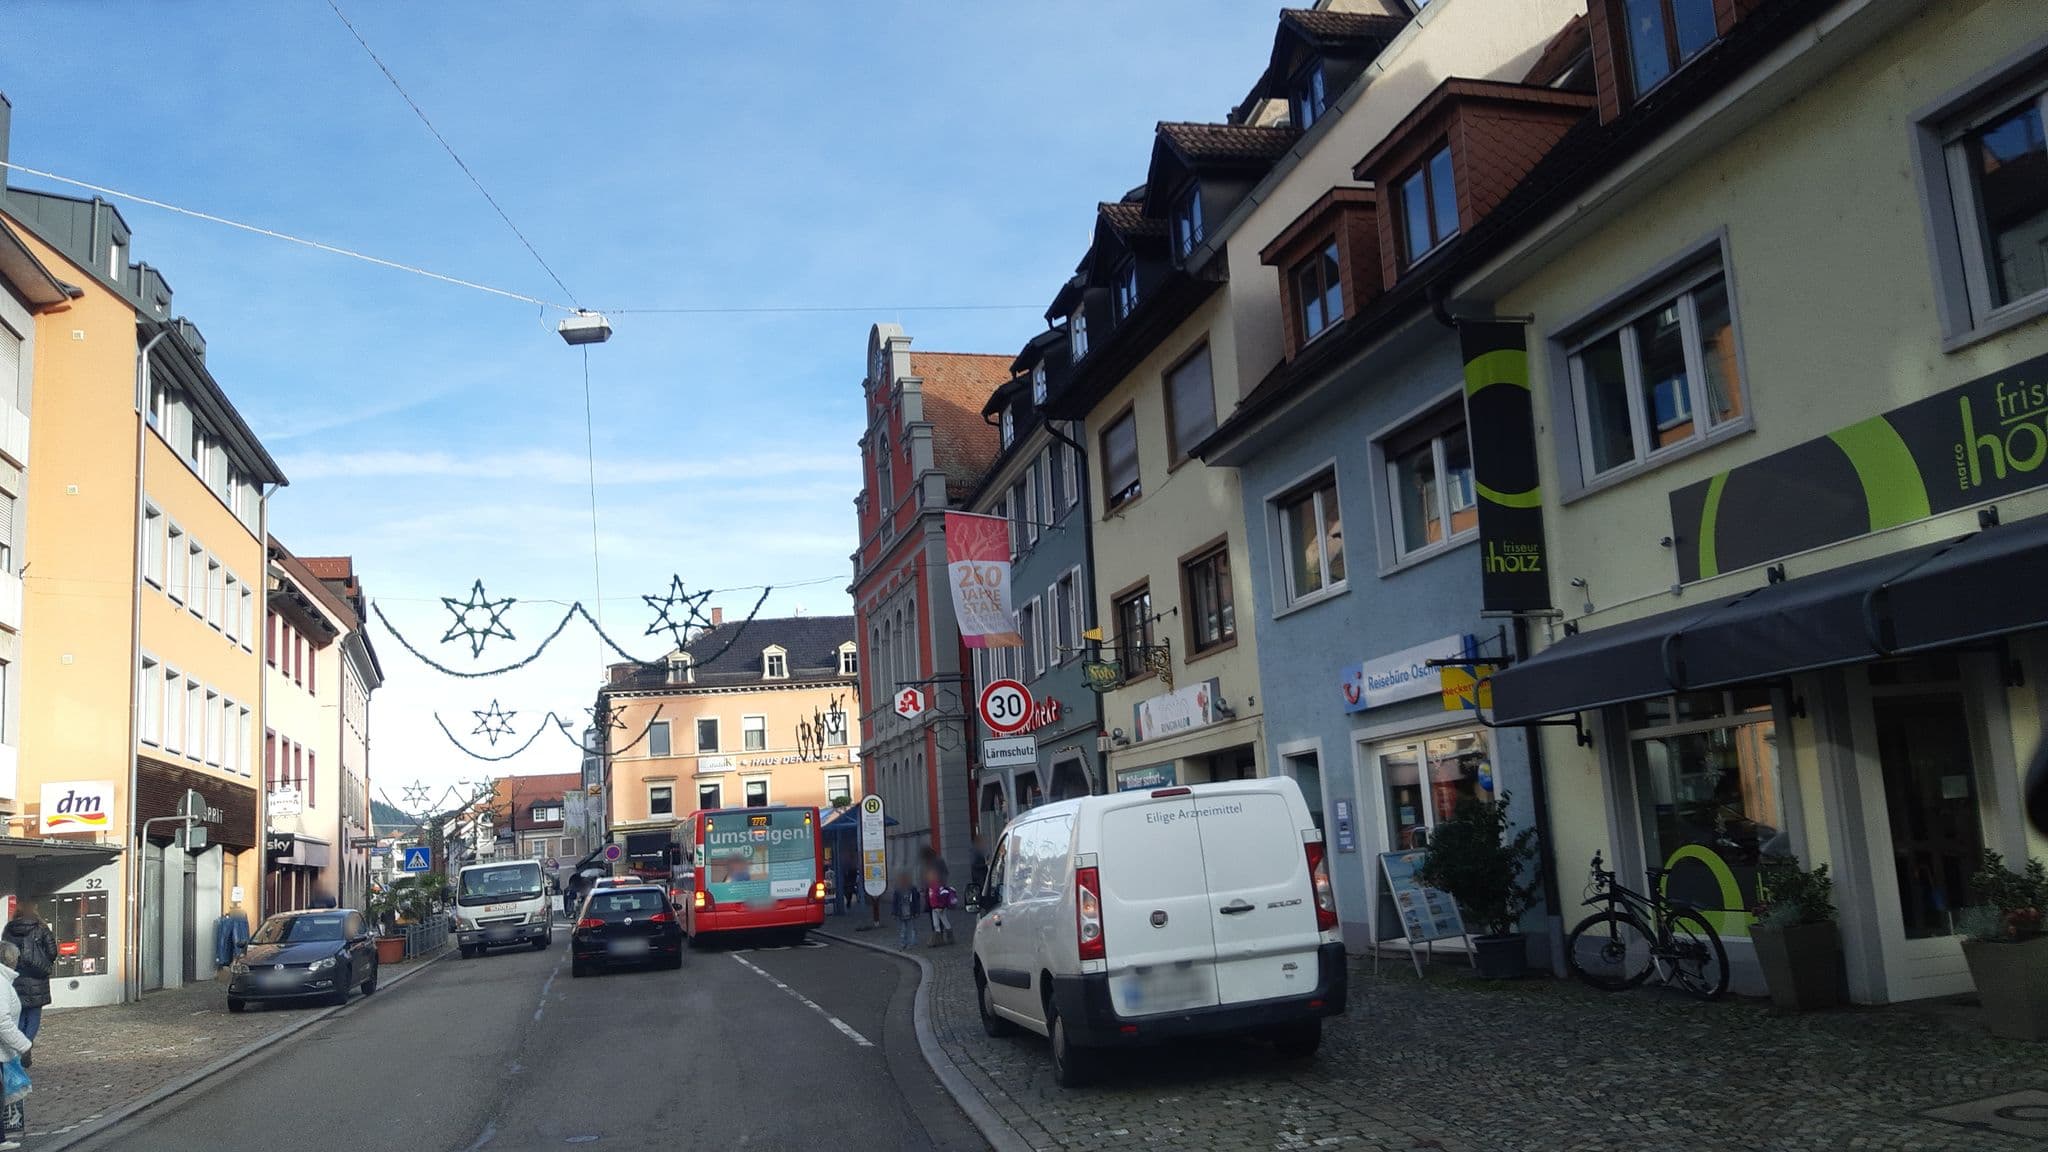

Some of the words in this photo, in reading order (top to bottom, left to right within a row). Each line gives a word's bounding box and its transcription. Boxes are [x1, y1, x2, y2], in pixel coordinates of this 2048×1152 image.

[1996, 380, 2048, 418] fris
[1960, 395, 2048, 487] ho
[1954, 443, 1969, 491] marco
[1367, 669, 1410, 691] Reisebüro
[991, 693, 1022, 719] 30
[750, 756, 779, 767] HAUS
[985, 746, 1035, 760] Lärmschutz
[56, 789, 101, 814] dm
[1146, 811, 1176, 825] Eilige
[1178, 802, 1243, 820] Arzneimittel
[267, 838, 290, 852] sky
[710, 825, 811, 845] umsteigen!
[86, 878, 102, 890] 32
